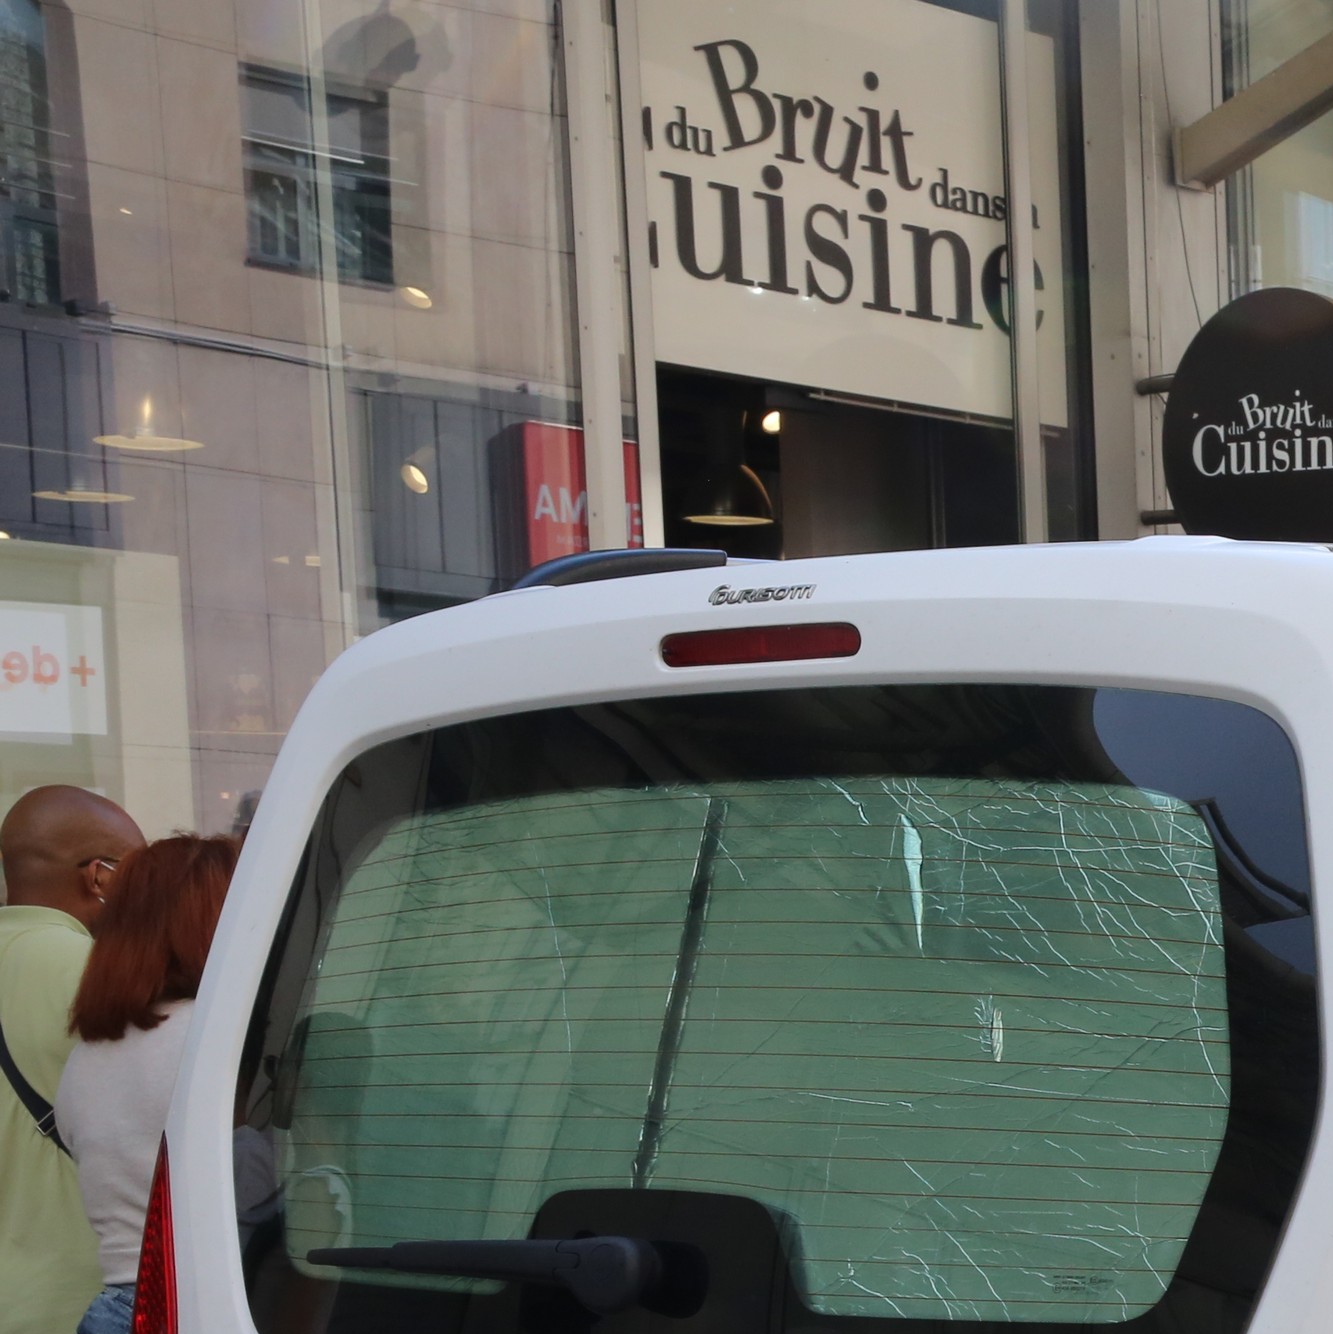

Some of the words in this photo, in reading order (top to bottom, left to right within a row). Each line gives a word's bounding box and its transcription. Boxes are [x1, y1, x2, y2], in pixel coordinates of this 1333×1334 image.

[643, 107, 1045, 338] uisine
[665, 105, 718, 157] du
[693, 38, 923, 193] Bruit
[928, 166, 1009, 223] dans
[1227, 421, 1244, 436] du
[1238, 389, 1316, 431] Bruit
